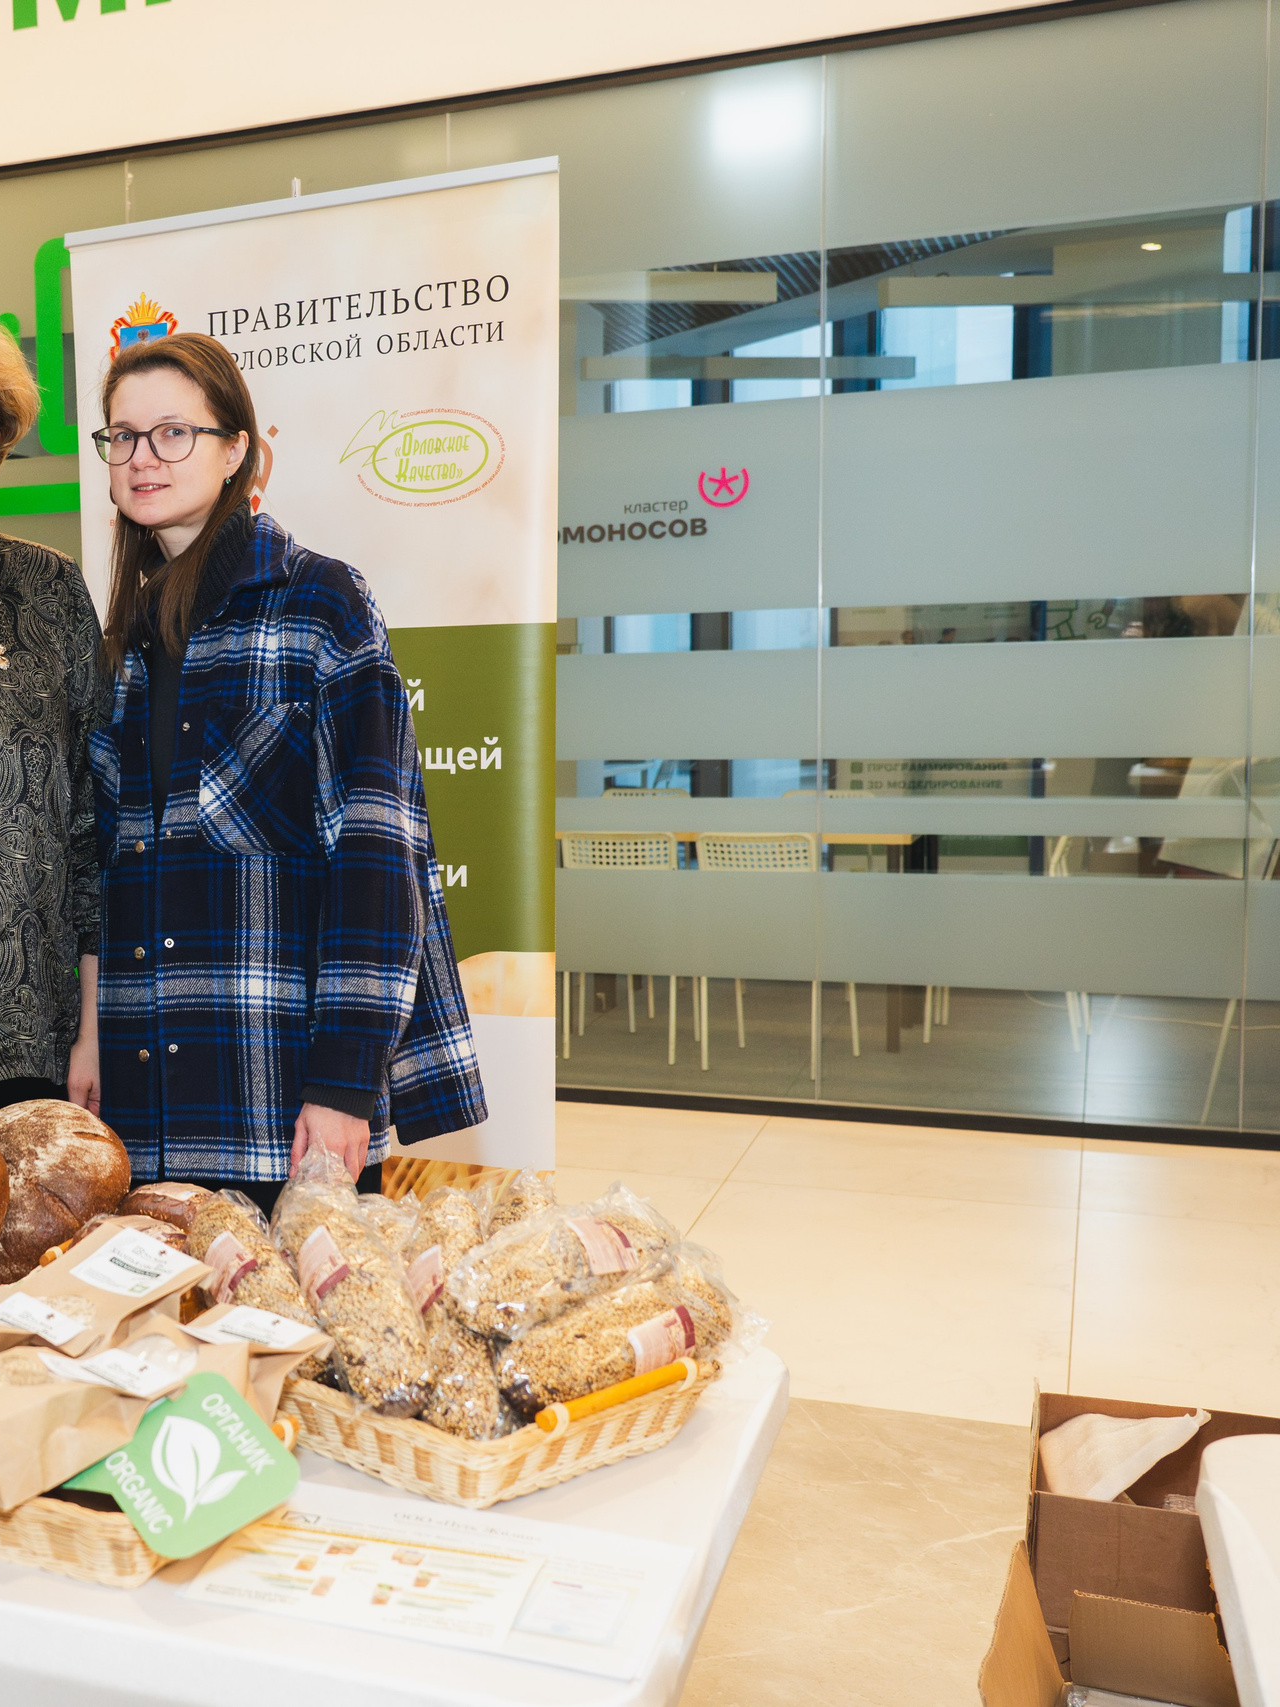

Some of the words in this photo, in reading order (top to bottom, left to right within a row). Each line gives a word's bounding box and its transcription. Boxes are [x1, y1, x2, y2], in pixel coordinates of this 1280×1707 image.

[207, 274, 510, 337] ПРАВИТЕЛЬСТВО
[376, 320, 505, 355] ОБЛАСТИ
[400, 407, 434, 419] АССОЦИАЦИЯ
[623, 499, 689, 515] кластер
[558, 517, 708, 545] МОНОСОВ
[417, 736, 502, 775] щей
[867, 761, 1008, 772] ПРОГРАММИРОВАНИЕ
[201, 1393, 276, 1476] ОРГАНИК
[104, 1451, 174, 1535] ORGANIC
